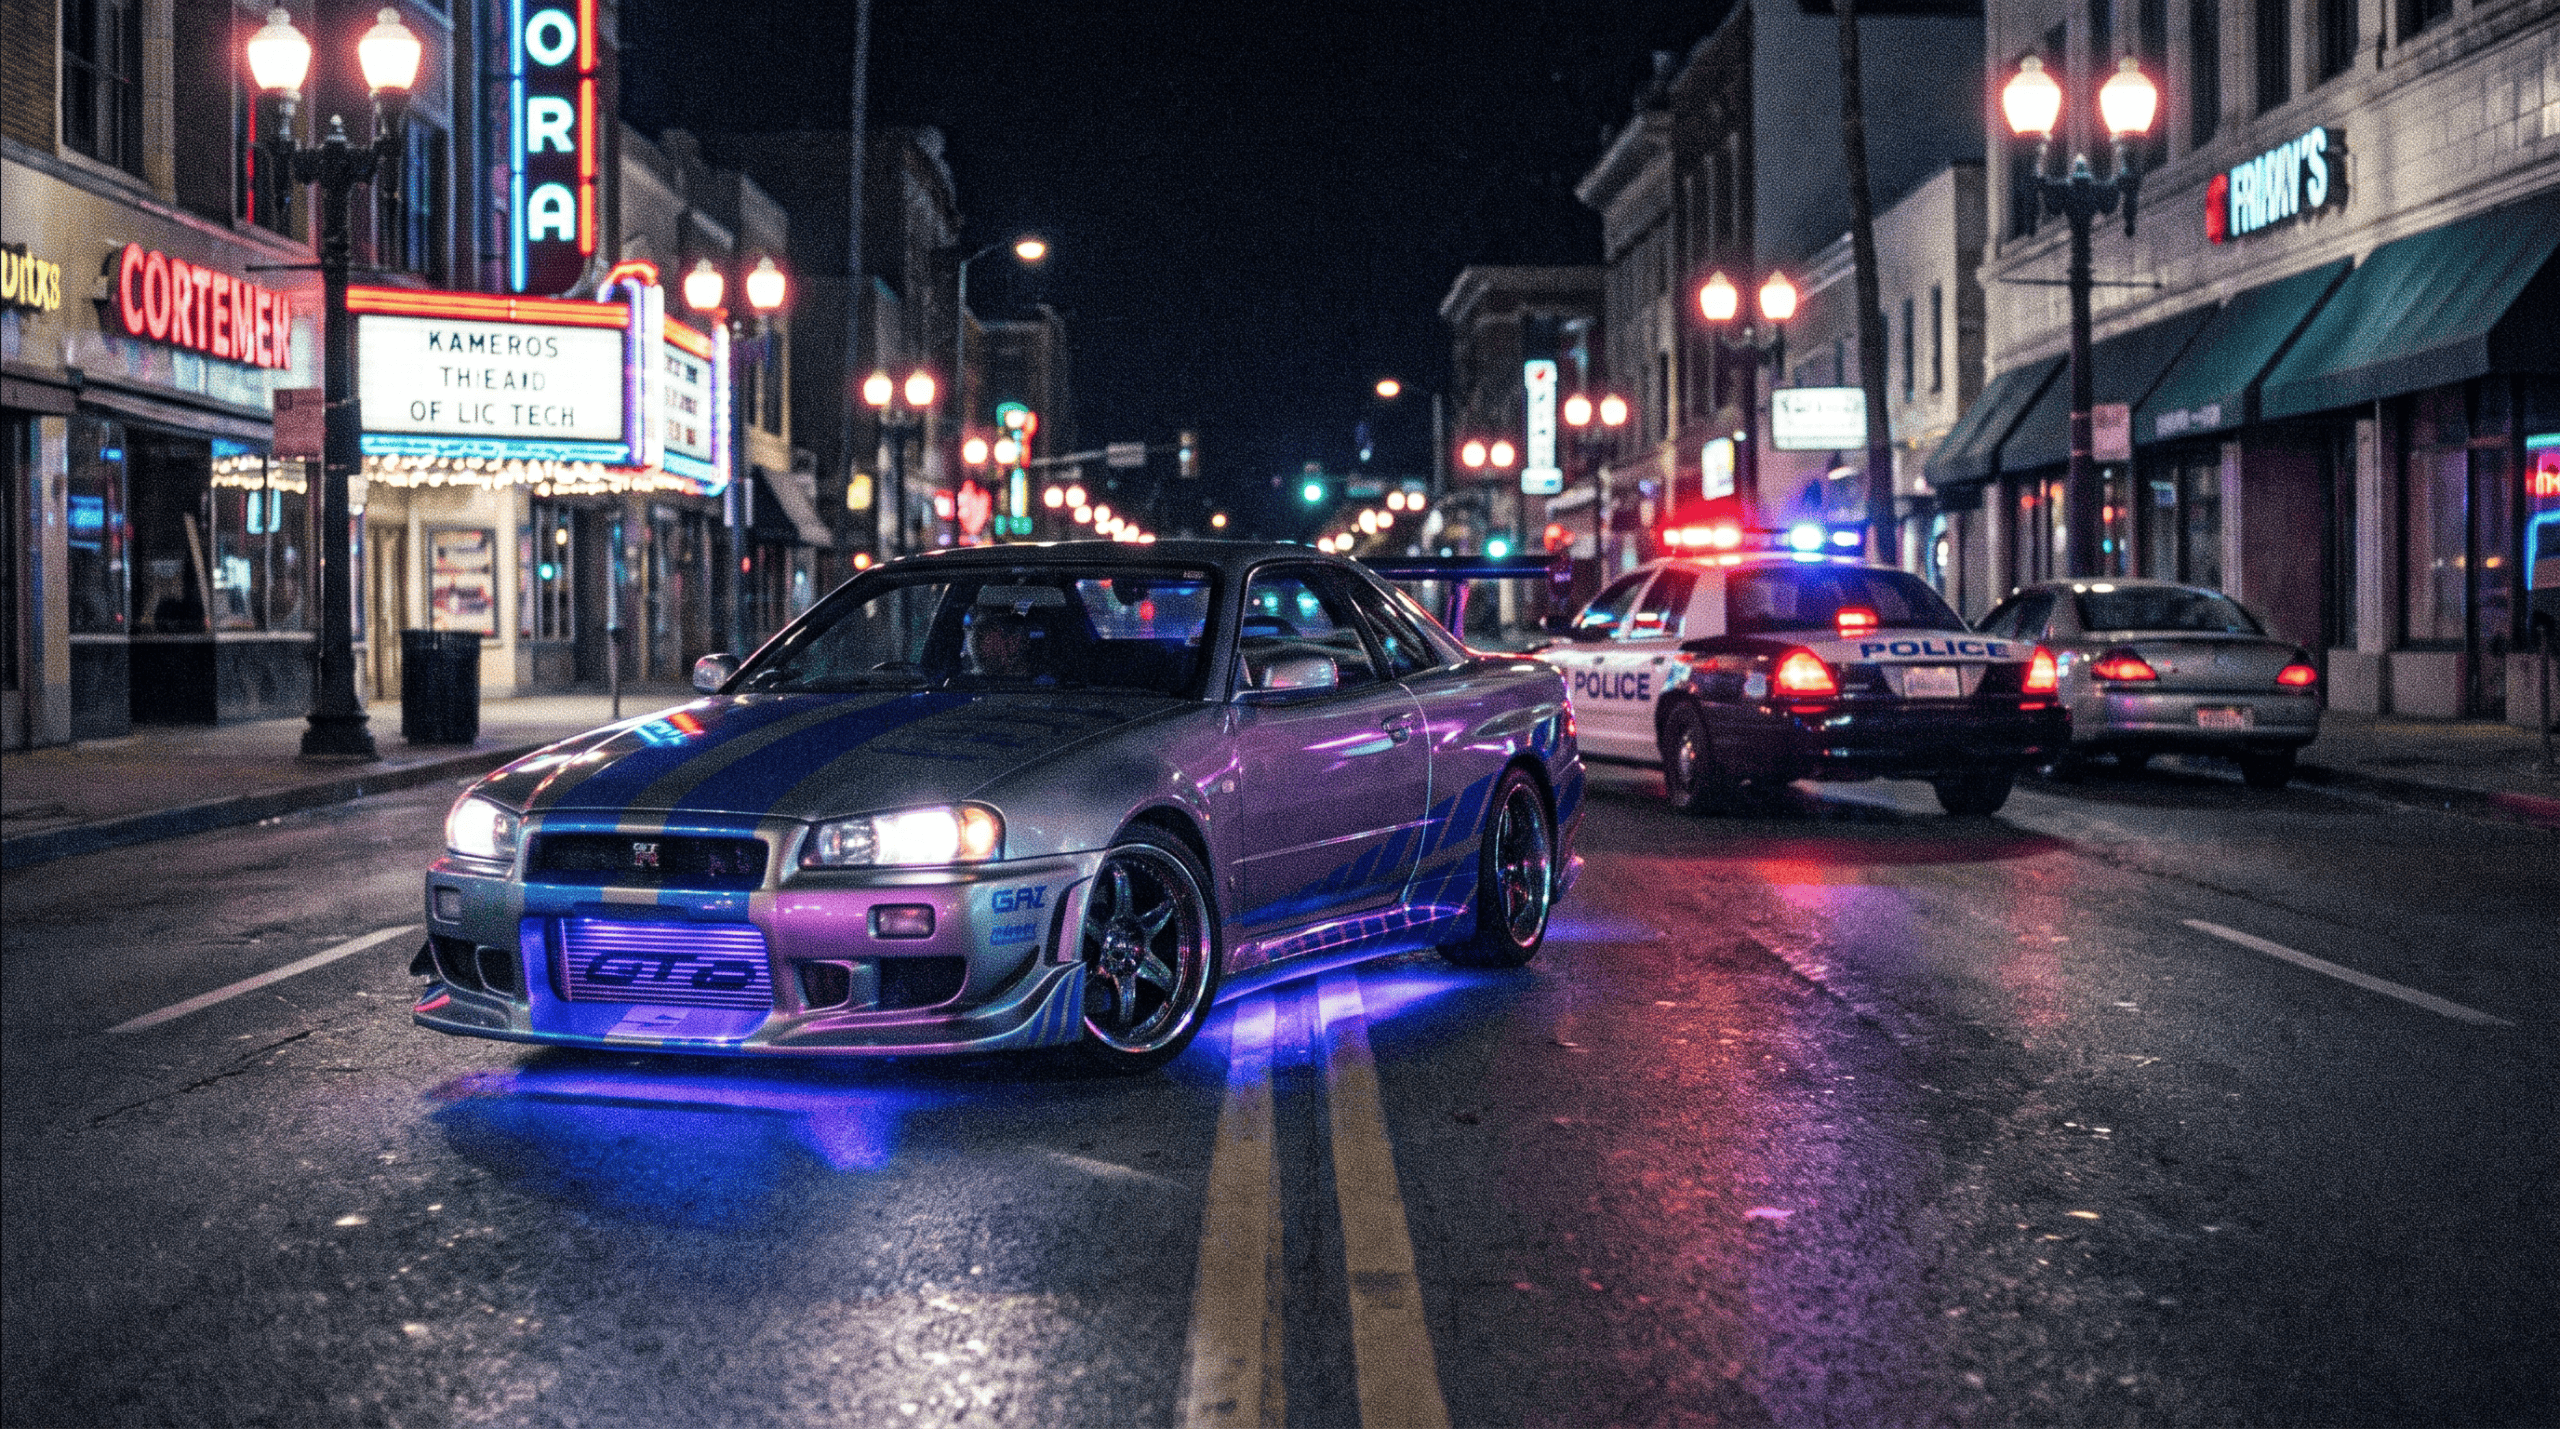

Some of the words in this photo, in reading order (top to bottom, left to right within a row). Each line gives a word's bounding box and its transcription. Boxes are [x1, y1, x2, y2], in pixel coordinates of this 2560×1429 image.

[524, 8, 577, 242] ORA
[429, 331, 558, 358] KAMEROS
[410, 400, 442, 422] OF
[510, 404, 575, 427] TECH
[1860, 640, 2010, 658] POLICE
[1574, 670, 1651, 701] POLICE
